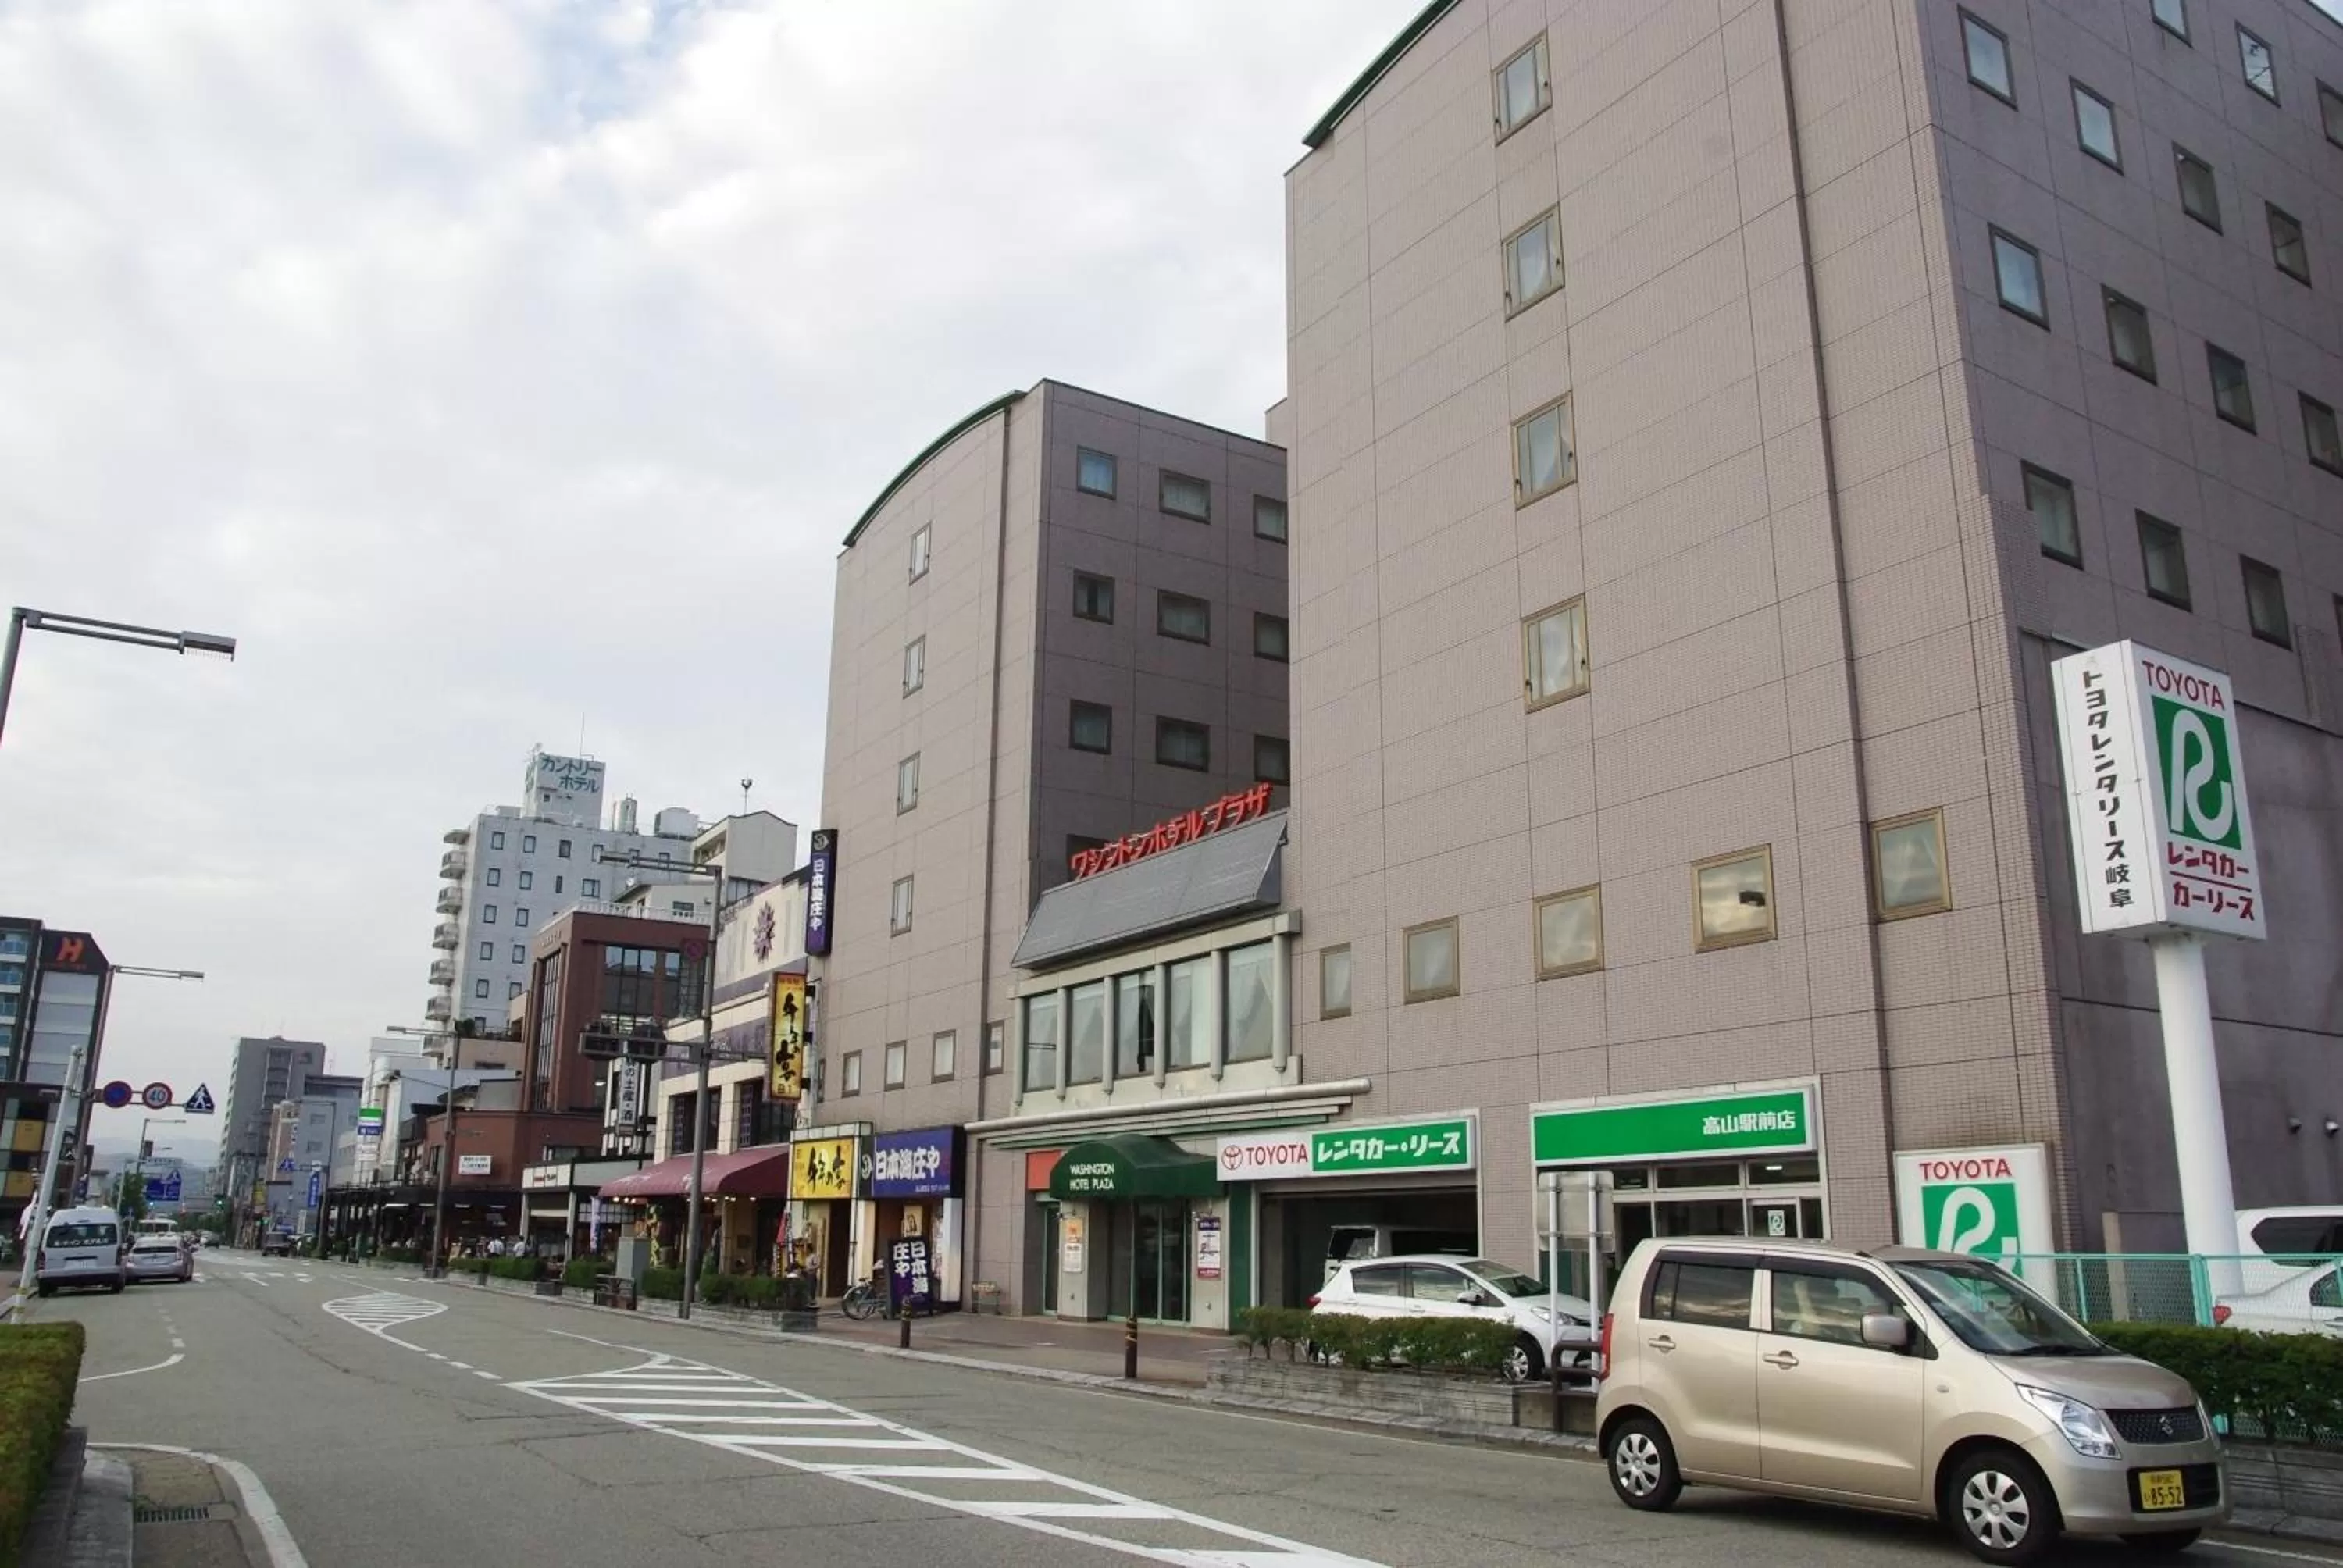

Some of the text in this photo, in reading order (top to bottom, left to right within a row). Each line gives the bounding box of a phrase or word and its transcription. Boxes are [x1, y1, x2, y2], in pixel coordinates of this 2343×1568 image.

[2142, 661, 2225, 710] TOYOTA
[540, 755, 604, 775] カントリー
[558, 775, 600, 793] ホテル
[2083, 670, 2134, 908] トヨタレンタリース岐阜
[1071, 782, 1274, 880] ワシントンホテルプラザ
[2167, 840, 2250, 879] レンタカー
[810, 858, 825, 932] 日本海庄や
[2173, 879, 2255, 922] カーリース
[149, 1089, 167, 1102] 40
[1703, 1110, 1796, 1135] 高山駅前店
[1246, 1144, 1308, 1166] TOYOTA
[1318, 1132, 1460, 1163] レンタカー・リース
[876, 1146, 940, 1180] 日本海庄や
[1070, 1163, 1114, 1174] WASHINGTON
[1920, 1159, 2012, 1180] TOYOTA
[1070, 1178, 1114, 1190] HOTEL PLAZA
[893, 1242, 910, 1278] 庄や
[2151, 1486, 2182, 1506] 85-52
